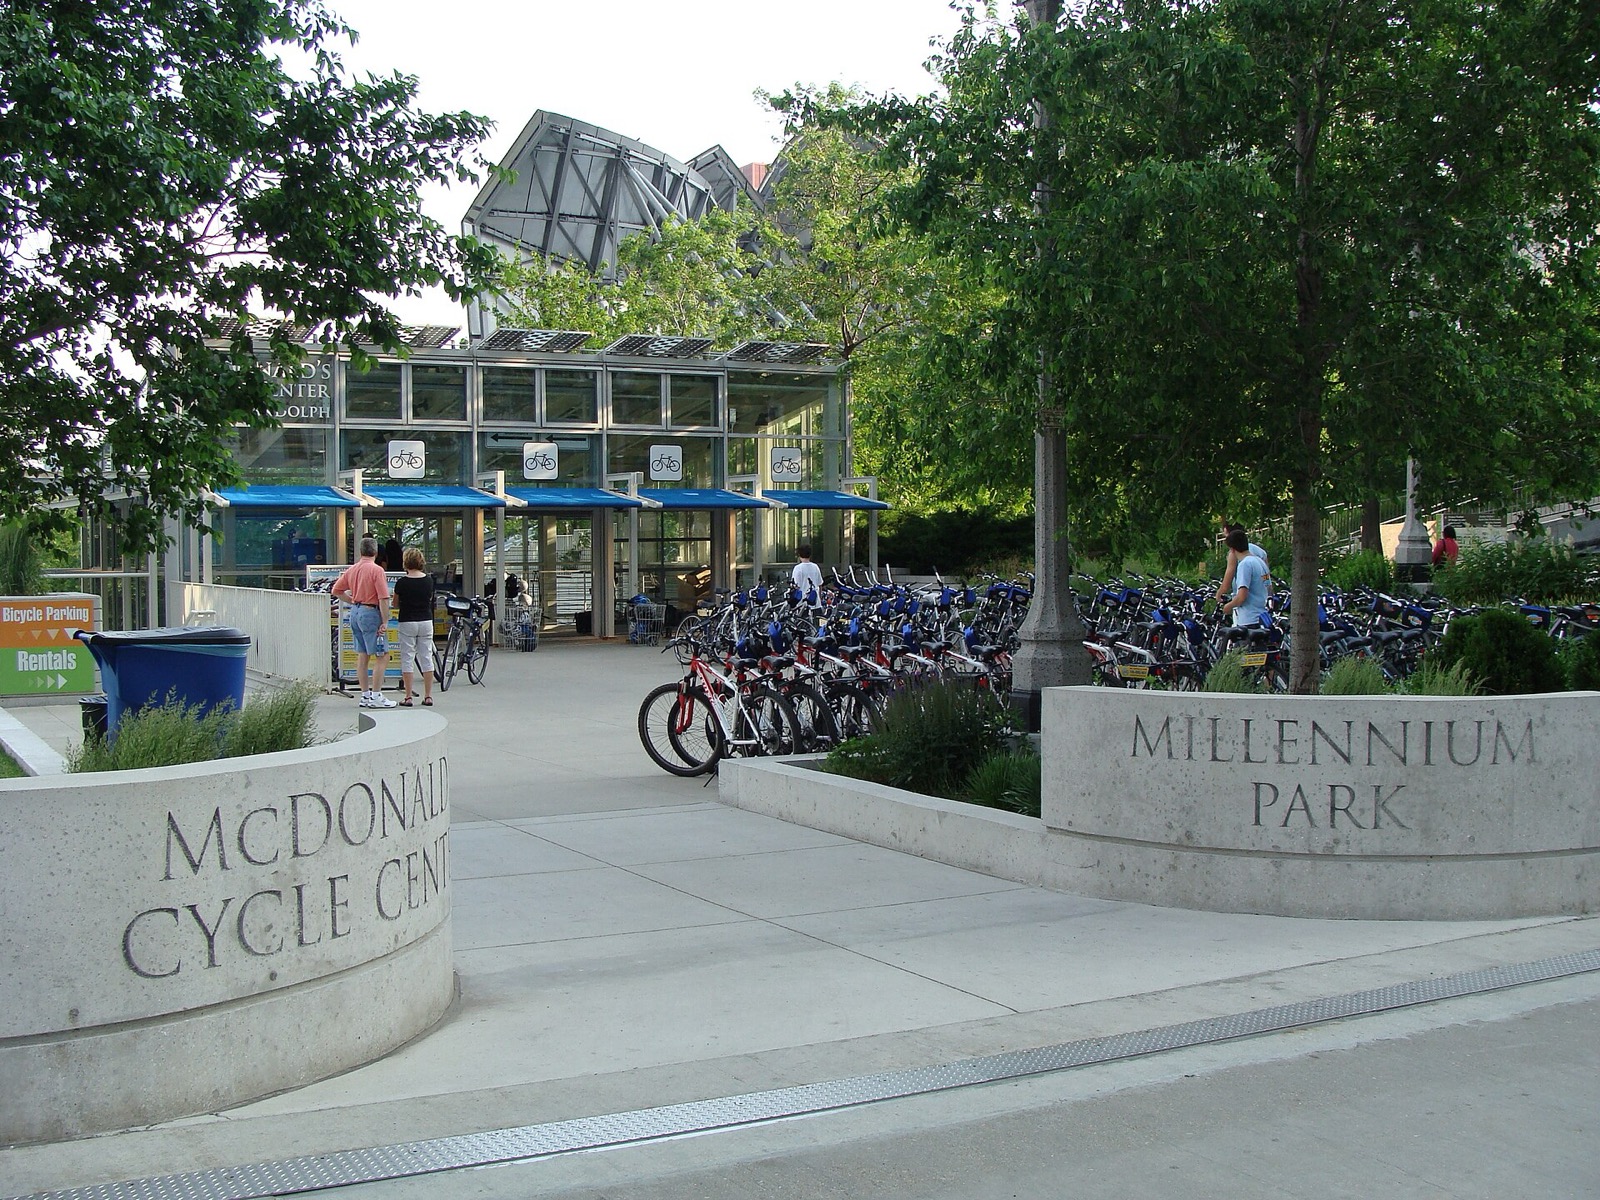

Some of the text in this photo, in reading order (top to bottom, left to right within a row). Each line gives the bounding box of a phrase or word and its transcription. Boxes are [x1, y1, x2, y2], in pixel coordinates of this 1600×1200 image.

[273, 383, 331, 398] NTER
[2, 606, 89, 623] Bicycle Parking
[17, 650, 77, 671] Rentals
[1130, 713, 1545, 767] MILLENNIUM
[159, 756, 449, 882] MCDONALD
[1250, 781, 1412, 830] PARK
[122, 826, 450, 979] CYCLE CENT
